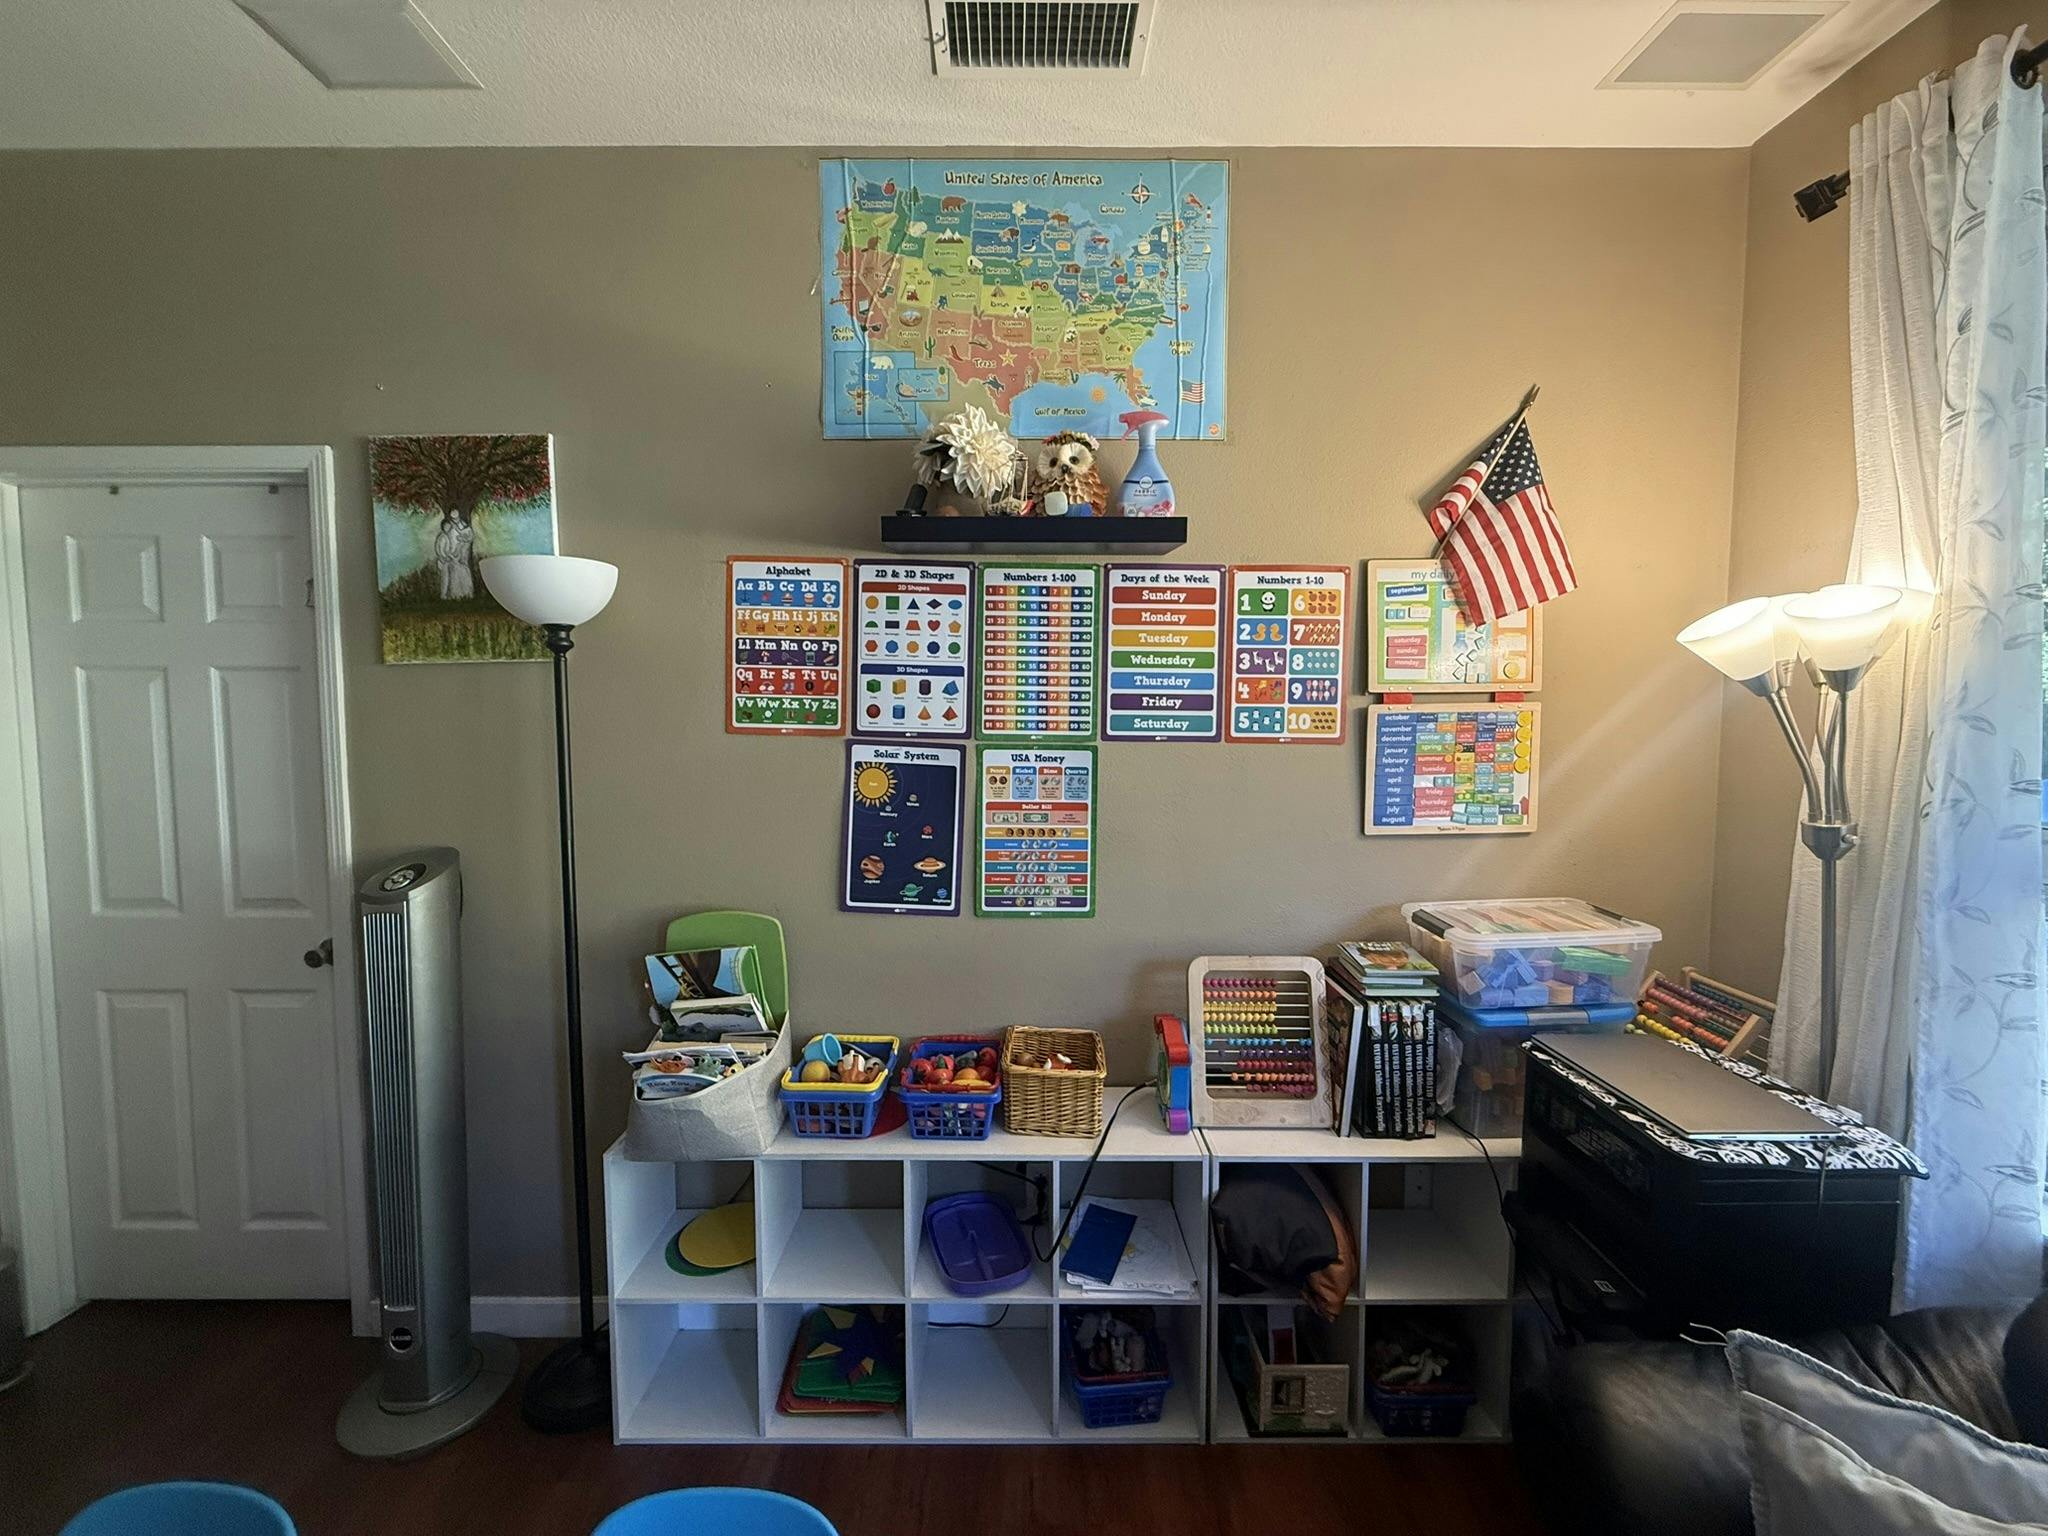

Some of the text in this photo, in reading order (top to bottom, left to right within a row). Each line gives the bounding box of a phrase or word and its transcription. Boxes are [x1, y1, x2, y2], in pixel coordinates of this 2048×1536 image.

[945, 172, 1102, 186] United States of America
[1100, 204, 1125, 214] Canada
[974, 359, 997, 368] Texas
[1034, 407, 1086, 416] Gulf of Mexico
[766, 566, 810, 577] Alphabet
[920, 571, 954, 581] Shapes
[1004, 573, 1076, 582] Numbers 1-100
[1411, 570, 1455, 580] my daily
[1121, 574, 1209, 584] Days of the Week
[1257, 576, 1324, 584] Numbers 1-10
[737, 582, 836, 592] Aa Bb Cc Dd Ee
[1391, 586, 1424, 594] september
[1142, 590, 1186, 601] Sunday
[1240, 594, 1251, 610] 1
[1294, 594, 1305, 611] 6
[737, 610, 837, 623] Ff Gg Hh Ii Jj Kk
[1141, 612, 1186, 623] Monday
[1239, 624, 1250, 640] 2
[1294, 624, 1306, 641] 7
[1139, 633, 1188, 645] Tuesday
[738, 640, 837, 654] Ll Mm Nn Oo Pp
[1131, 655, 1195, 667] Wednesday
[1239, 653, 1250, 670] 3
[1292, 654, 1304, 670] 8
[737, 670, 837, 681] Qq Rr Ss Tt Uu
[1134, 676, 1190, 688] Thursday
[1238, 682, 1250, 698] 4
[1291, 683, 1302, 700] 9
[737, 699, 836, 711] Vv Ww Xx Yy Zz
[1142, 697, 1182, 709] Friday
[1134, 719, 1189, 730] Saturday
[1239, 712, 1249, 728] 5
[1289, 713, 1311, 730] 10
[874, 750, 940, 761] Solar System
[1011, 754, 1065, 764] USA Money
